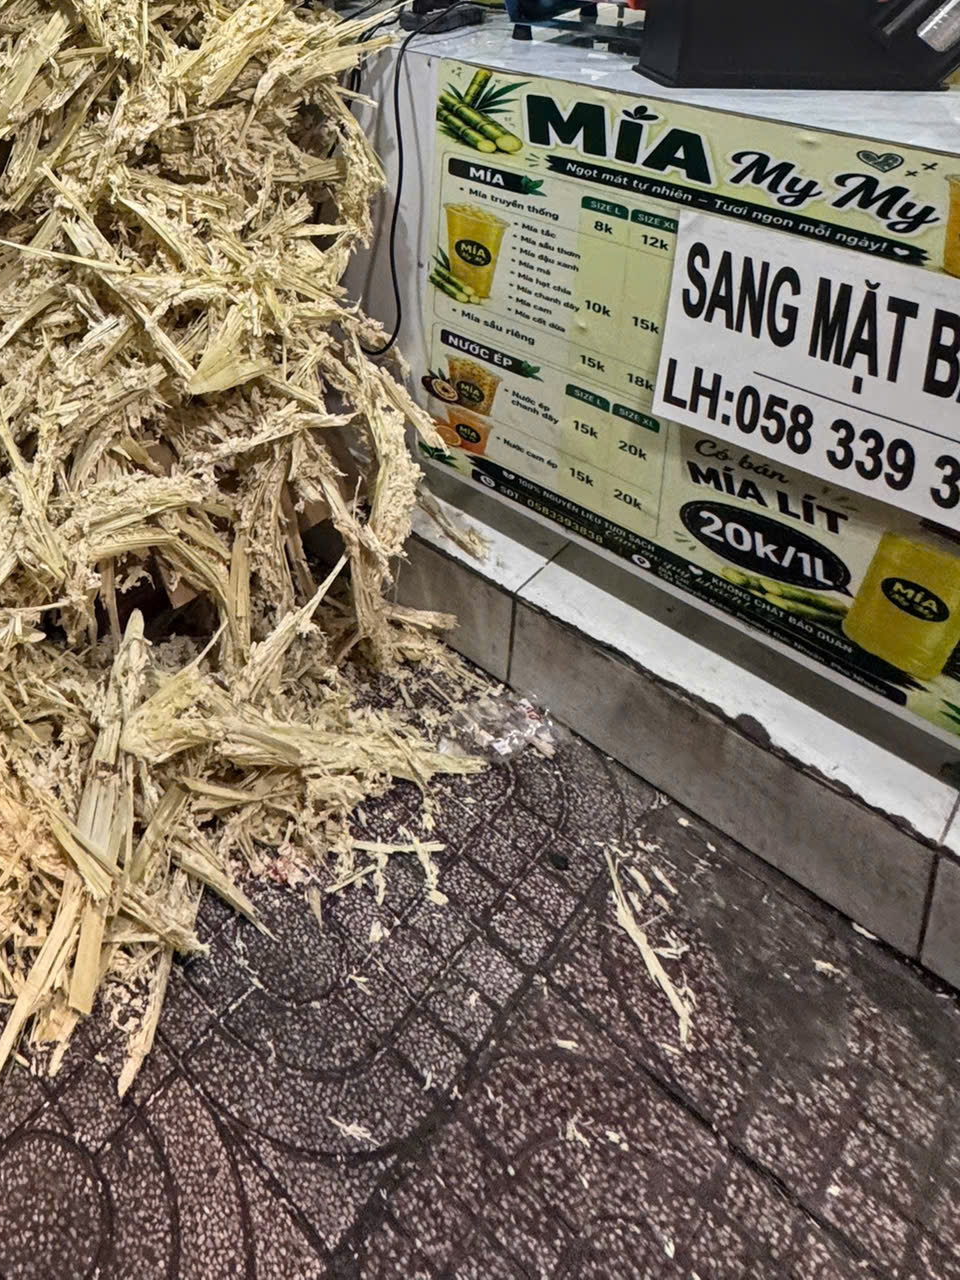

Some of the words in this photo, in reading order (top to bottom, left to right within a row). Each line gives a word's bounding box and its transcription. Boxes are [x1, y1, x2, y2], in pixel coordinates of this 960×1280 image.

[469, 166, 505, 186] MÍA
[729, 151, 823, 207] My
[832, 173, 940, 234] My
[566, 162, 598, 178] Ngọt
[601, 171, 628, 186] mát
[633, 179, 649, 191] tự
[652, 185, 692, 202] nhiên
[715, 198, 748, 215] Tươi
[752, 209, 793, 228] ngon
[798, 222, 831, 238] mỗi
[835, 231, 888, 252] ngày!
[590, 201, 611, 212] SIZE
[615, 207, 621, 215] L
[594, 221, 613, 235] 8k
[637, 214, 660, 225] SIZE
[664, 221, 675, 230] XL
[641, 234, 668, 251] 12k
[585, 300, 612, 317] 10k
[682, 242, 801, 347] SANG
[808, 279, 919, 394] MẶT
[632, 316, 660, 334] 15k
[506, 329, 535, 345] riêng
[448, 334, 489, 359] NƯỚC
[494, 353, 513, 367] ÉP
[580, 354, 605, 372] 15k
[626, 372, 654, 391] 18k
[574, 388, 595, 402] SIZE
[618, 407, 640, 421] SIZE
[573, 420, 598, 439] 15k
[663, 358, 813, 454] LH:058
[826, 419, 915, 491] 339
[618, 440, 647, 461] 20k
[694, 439, 734, 462] Có
[739, 454, 789, 484] bán
[569, 467, 594, 487] 15k
[613, 488, 642, 511] 20k
[687, 460, 768, 508] MÍA
[777, 489, 848, 535] LÍT
[699, 510, 834, 587] 20k/1L
